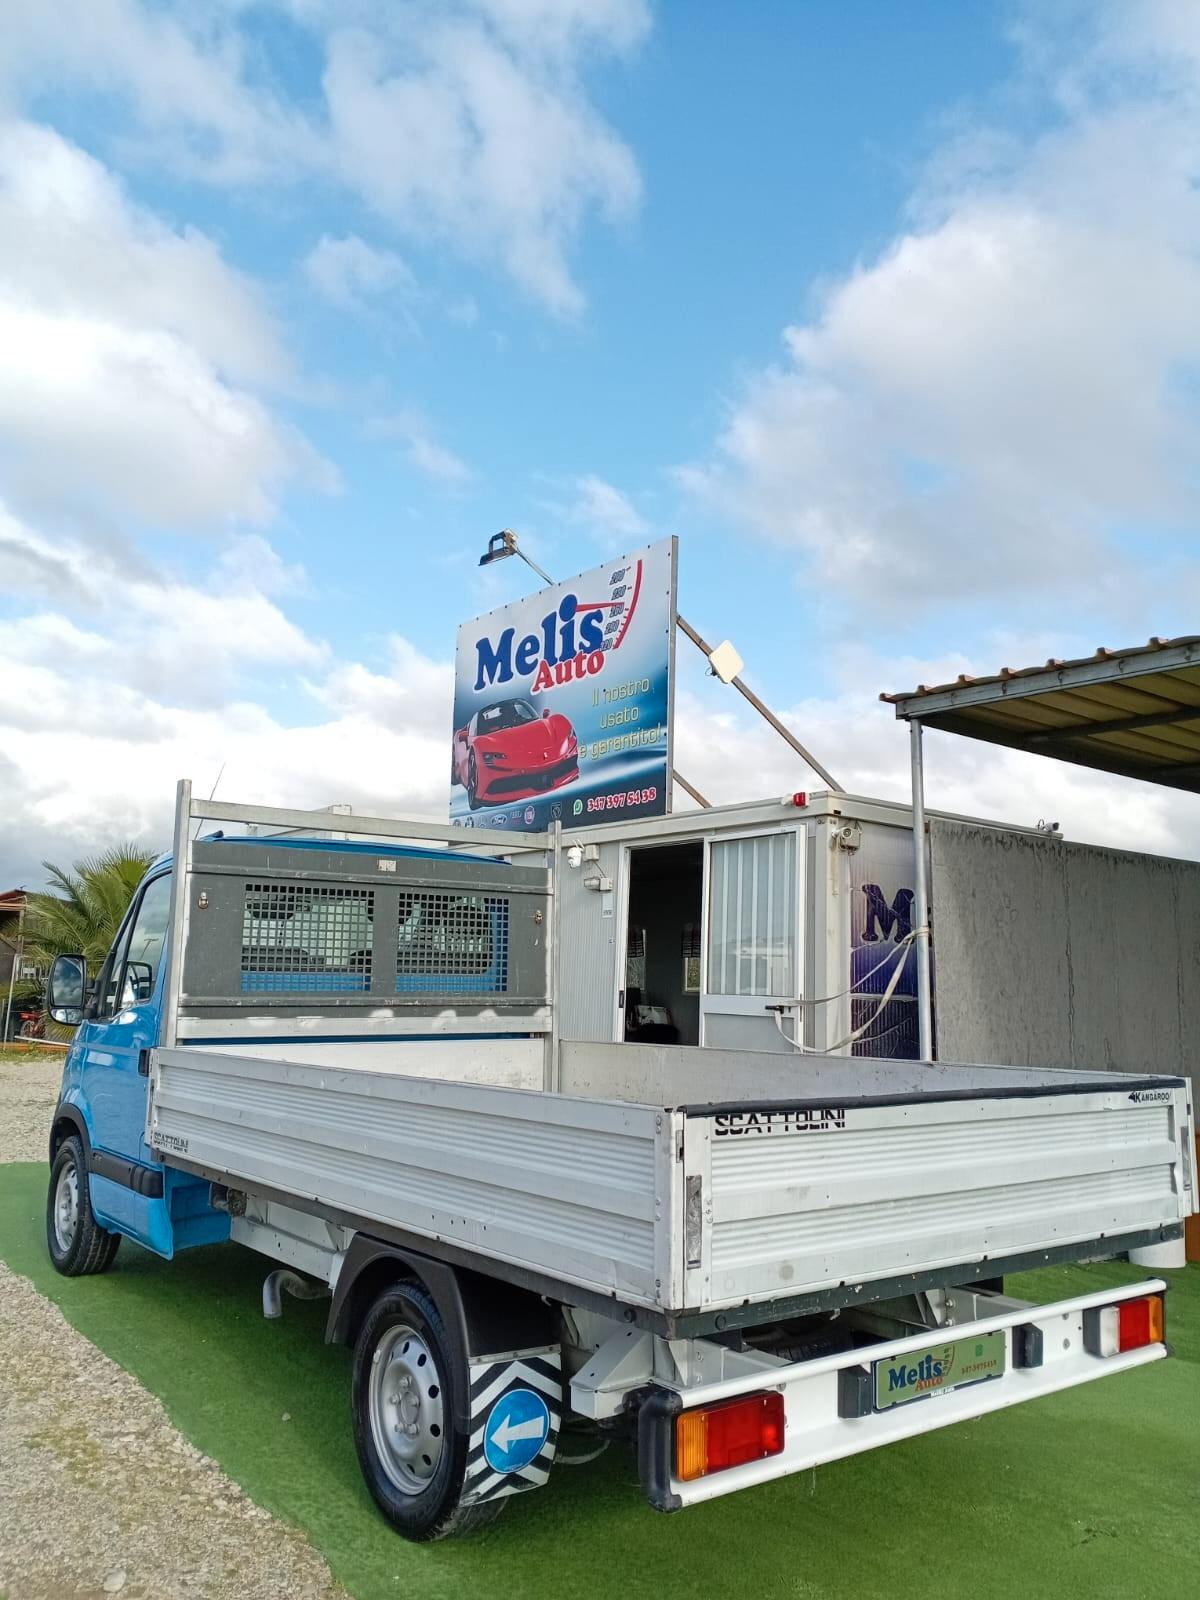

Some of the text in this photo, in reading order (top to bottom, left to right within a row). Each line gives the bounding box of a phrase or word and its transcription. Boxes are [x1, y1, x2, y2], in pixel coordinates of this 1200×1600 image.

[474, 594, 604, 691] Melis
[531, 651, 604, 692] Auto
[592, 678, 650, 707] Il nostro
[600, 706, 639, 730] usato
[591, 722, 661, 761] garantito!
[587, 786, 657, 812] 347 397 54 38
[714, 1108, 846, 1136] SCATTOLINI
[888, 1354, 943, 1392] Melis
